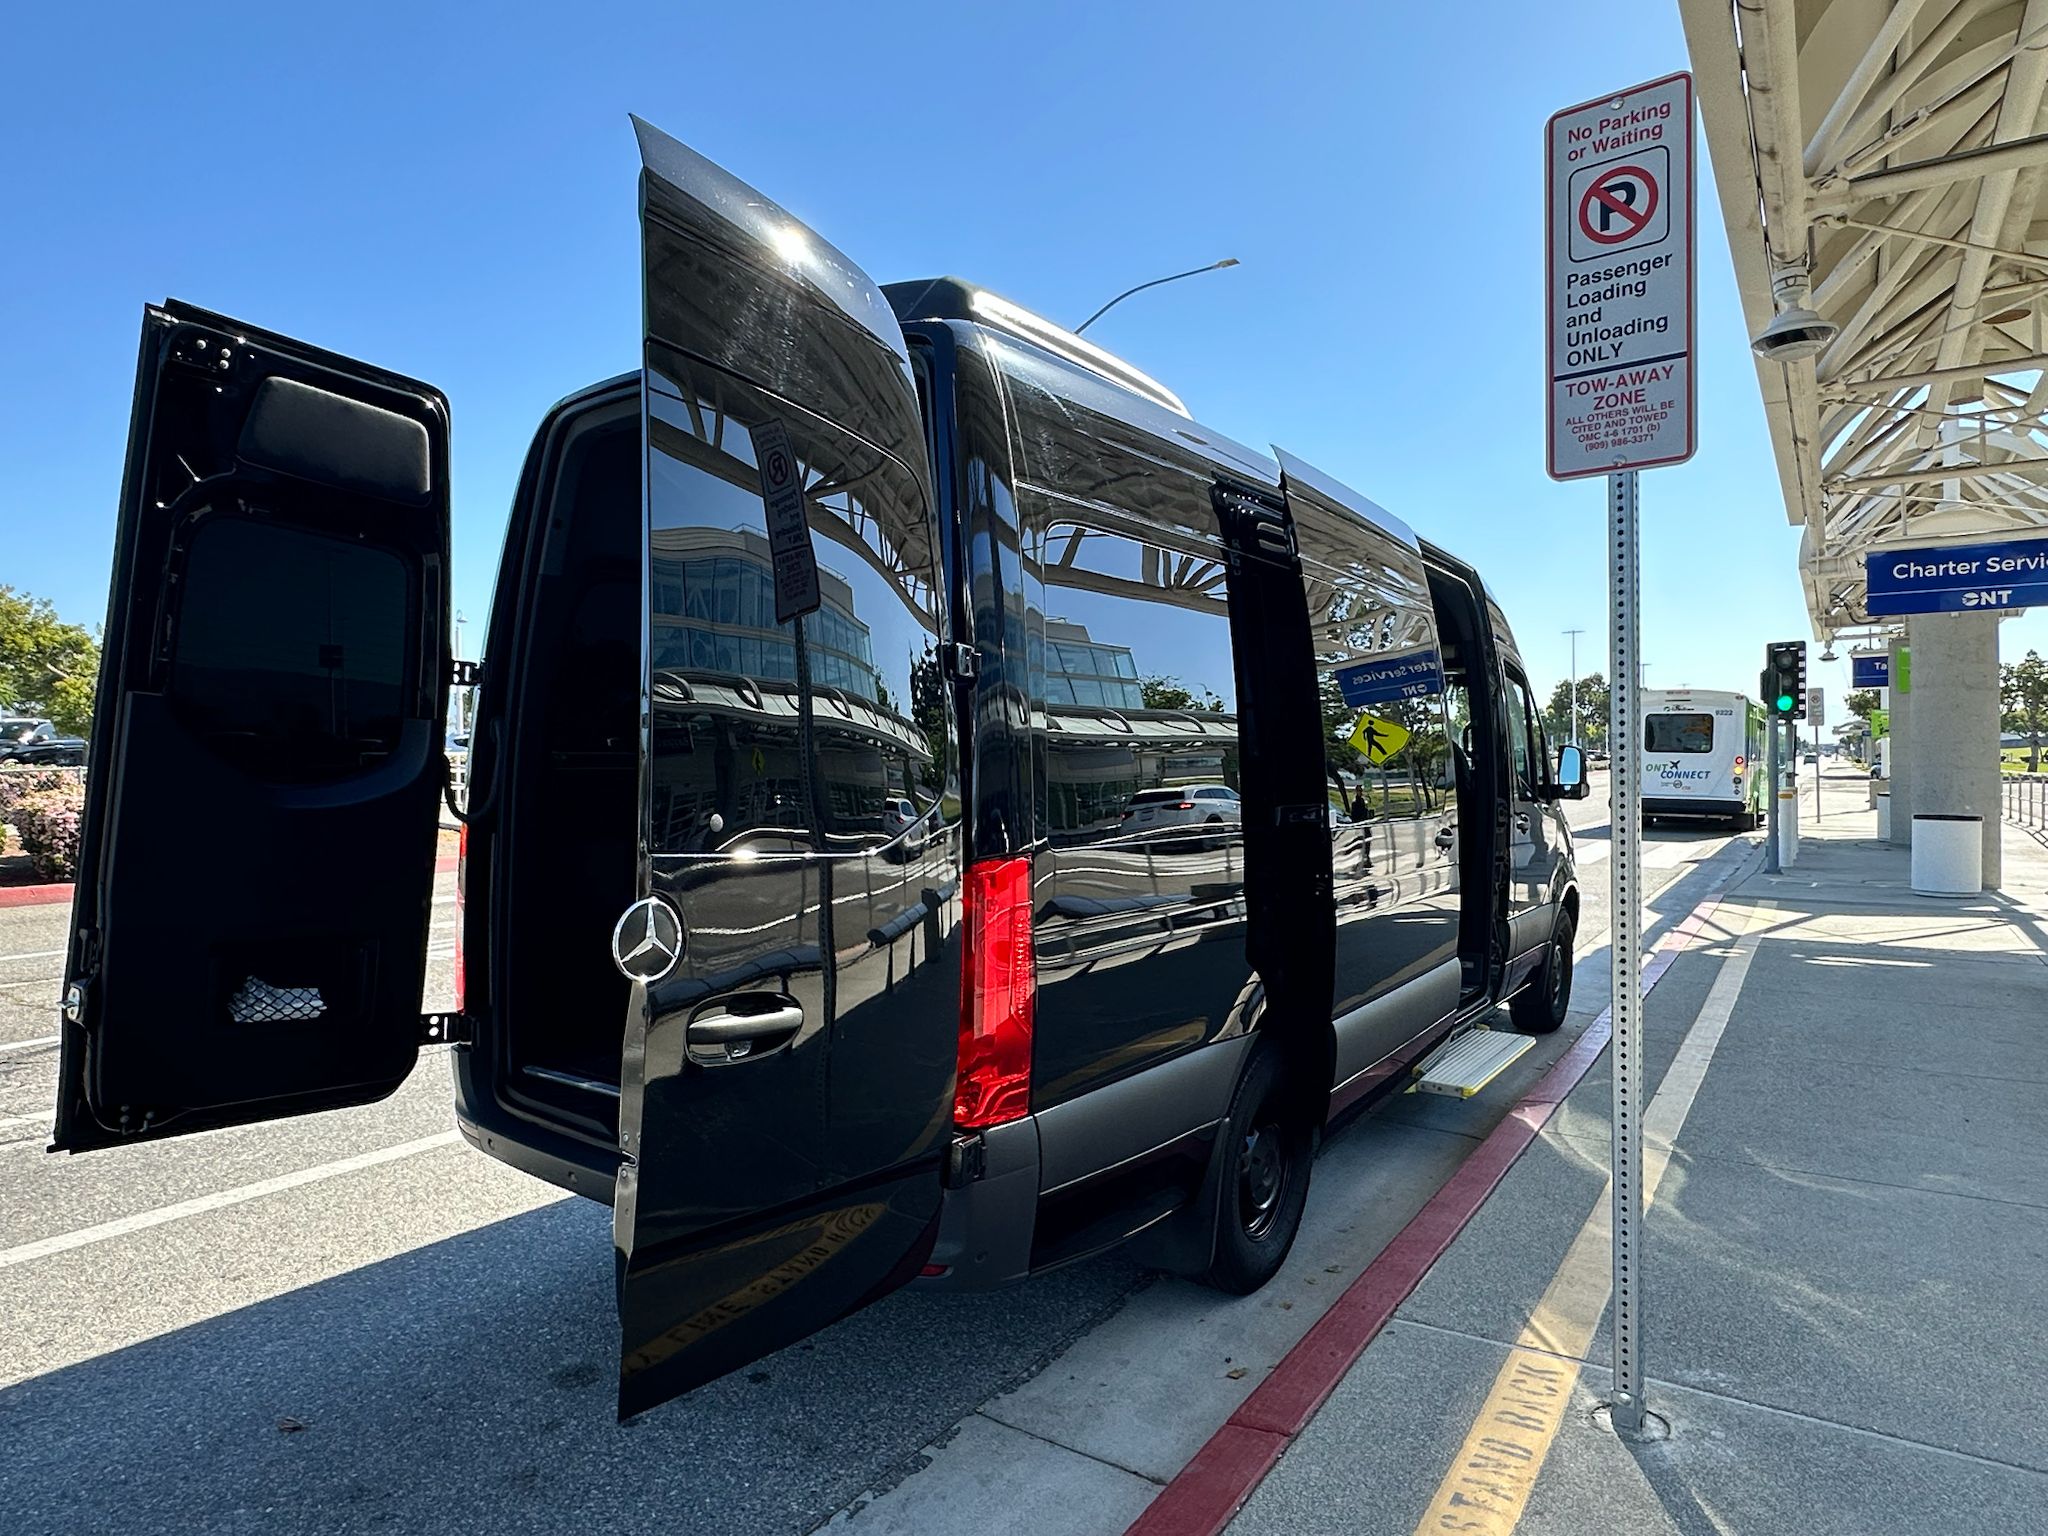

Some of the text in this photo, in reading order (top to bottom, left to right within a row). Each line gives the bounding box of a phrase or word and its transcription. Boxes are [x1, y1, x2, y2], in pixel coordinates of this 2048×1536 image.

[1568, 102, 1671, 144] No Parking
[1567, 123, 1664, 162] or Waiting
[1566, 253, 1673, 290] Passenger
[1566, 280, 1646, 309] Loading
[1566, 307, 1602, 329] and
[1567, 315, 1668, 348] Unloading
[1566, 341, 1623, 367] ONLY
[1565, 364, 1675, 398] TOW-AWAY
[1593, 388, 1646, 411] ZONE
[1565, 400, 1675, 427] ALL OTHERS WILL BE
[1571, 411, 1668, 435] CITED AND TOWED
[1578, 432, 1601, 443] OMC
[1622, 424, 1643, 435] 1701
[1647, 421, 1661, 433] (b)
[1892, 552, 2048, 579] Charter Servi
[1874, 661, 1888, 671] Ta
[1645, 763, 1669, 772] ONT
[1660, 770, 1711, 780] CONNECT
[1494, 1361, 1565, 1434] BACK
